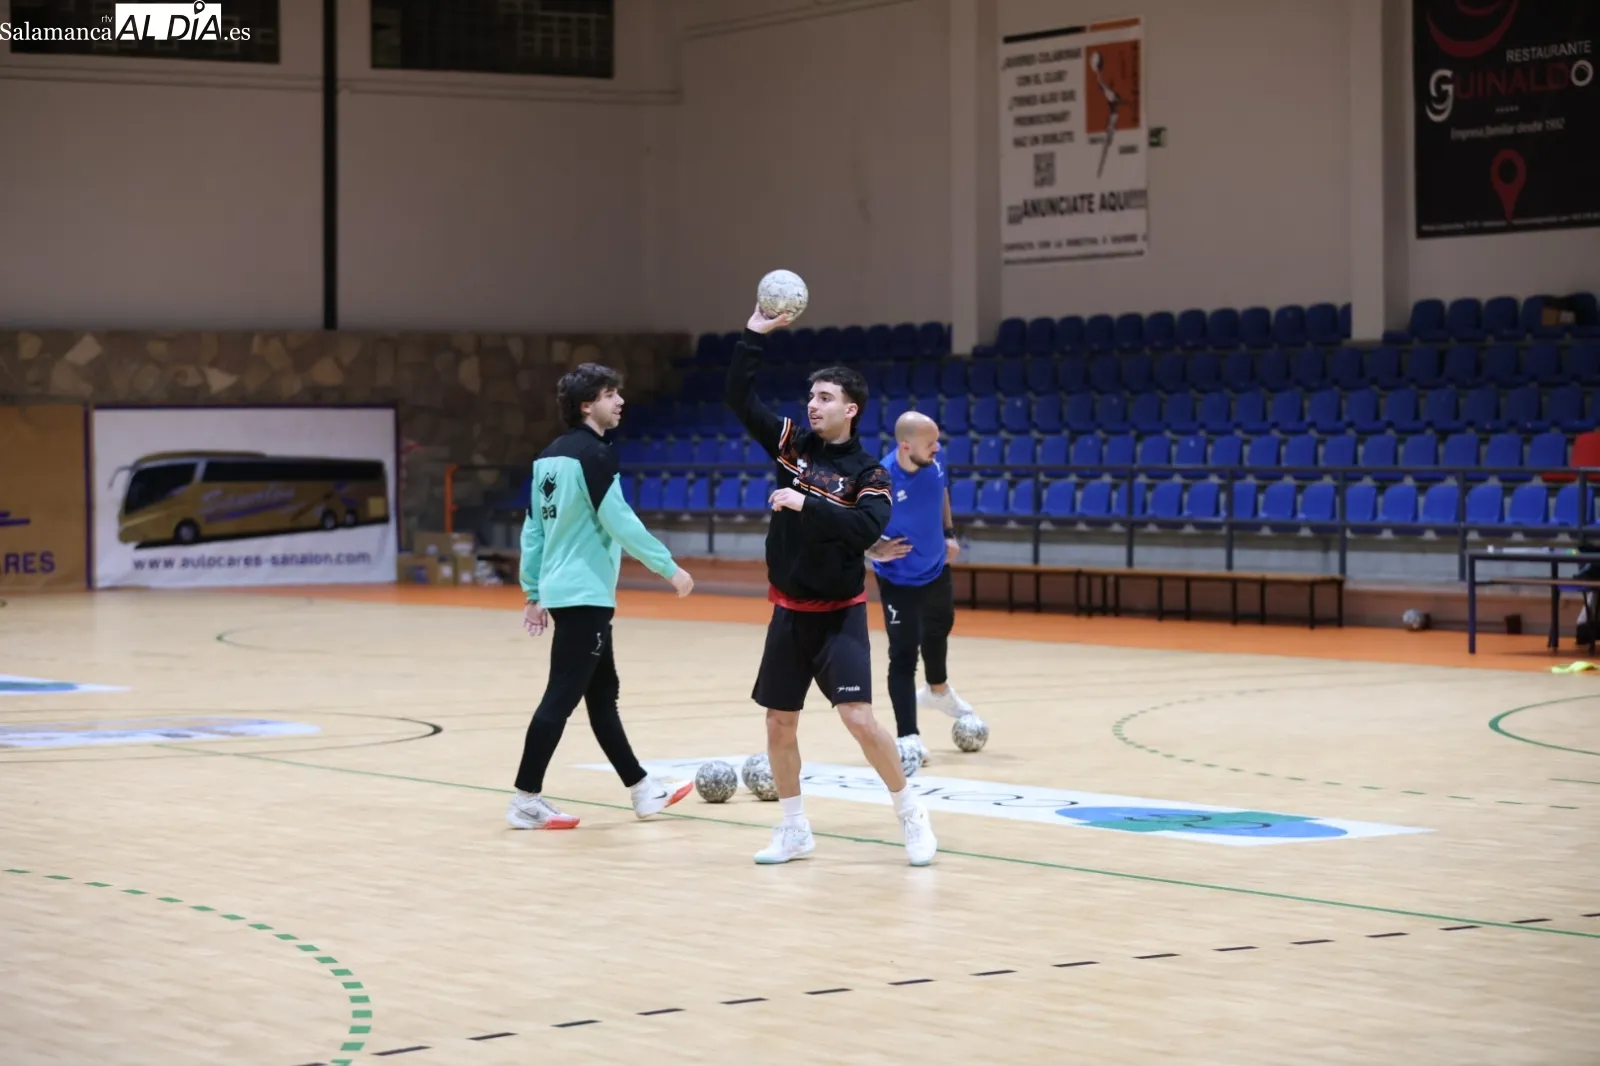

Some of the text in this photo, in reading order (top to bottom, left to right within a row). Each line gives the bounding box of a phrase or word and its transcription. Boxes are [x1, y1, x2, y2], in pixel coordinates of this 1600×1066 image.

[1506, 40, 1592, 62] RESTAURANTE
[1425, 60, 1593, 122] GUINALDO
[0, 551, 55, 576] RES
